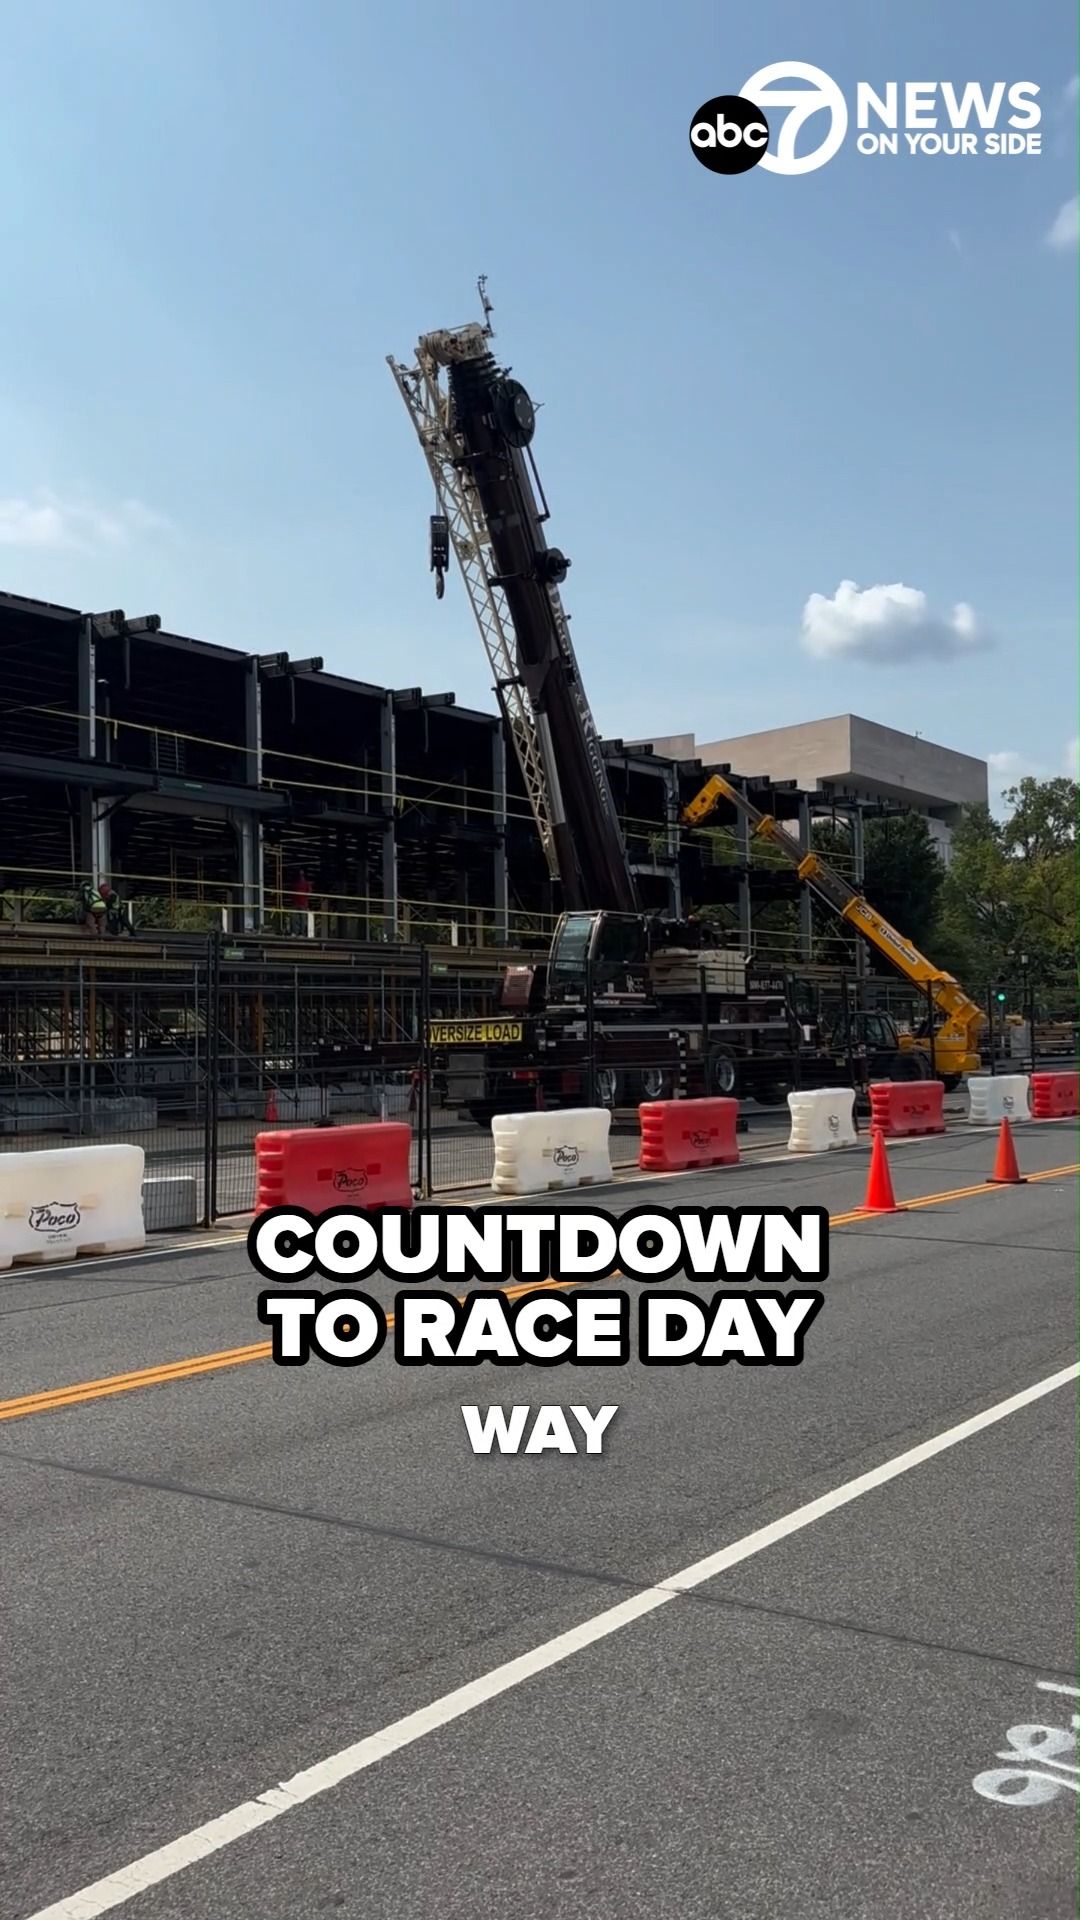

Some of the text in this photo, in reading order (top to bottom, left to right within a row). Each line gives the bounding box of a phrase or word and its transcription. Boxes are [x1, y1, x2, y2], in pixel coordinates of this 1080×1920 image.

[855, 904, 873, 921] JCB
[485, 1024, 520, 1041] LOAD
[556, 1149, 578, 1163] Poco
[336, 1172, 366, 1189] Poco
[34, 1208, 77, 1228] Poco
